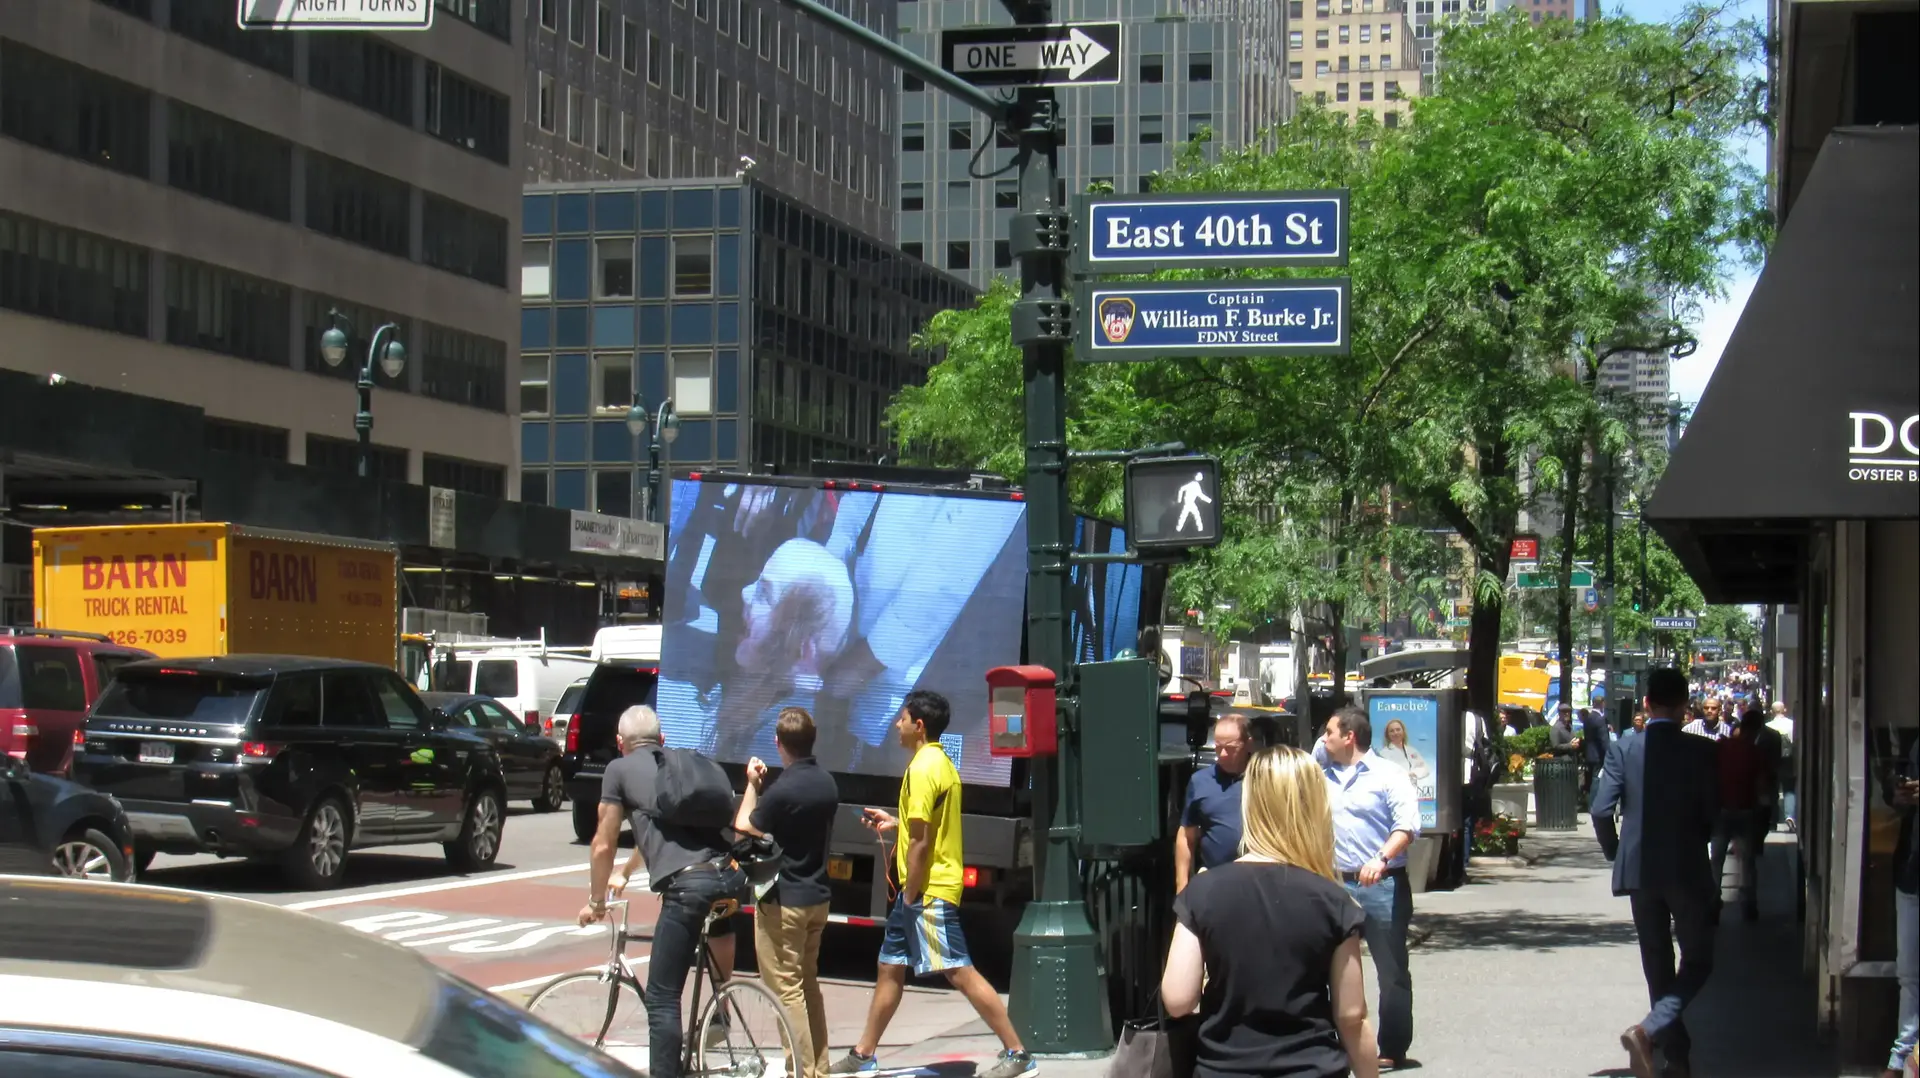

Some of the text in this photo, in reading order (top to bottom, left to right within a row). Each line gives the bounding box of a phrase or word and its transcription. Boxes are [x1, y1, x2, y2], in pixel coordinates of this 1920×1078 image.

[967, 43, 1092, 68] ONE WAY
[1106, 212, 1323, 249] East 40th St
[1207, 292, 1265, 307] Captain
[1140, 307, 1335, 330] William F. Burke Jr.
[1197, 330, 1279, 343] FDNY Street
[1848, 468, 1919, 482] OYSTER B
[622, 525, 659, 553] pharmacy
[82, 552, 187, 590] BARN
[250, 550, 318, 604] BARN
[83, 595, 188, 617] TRUCK RENTAL
[109, 724, 208, 735] RANGE ROVER
